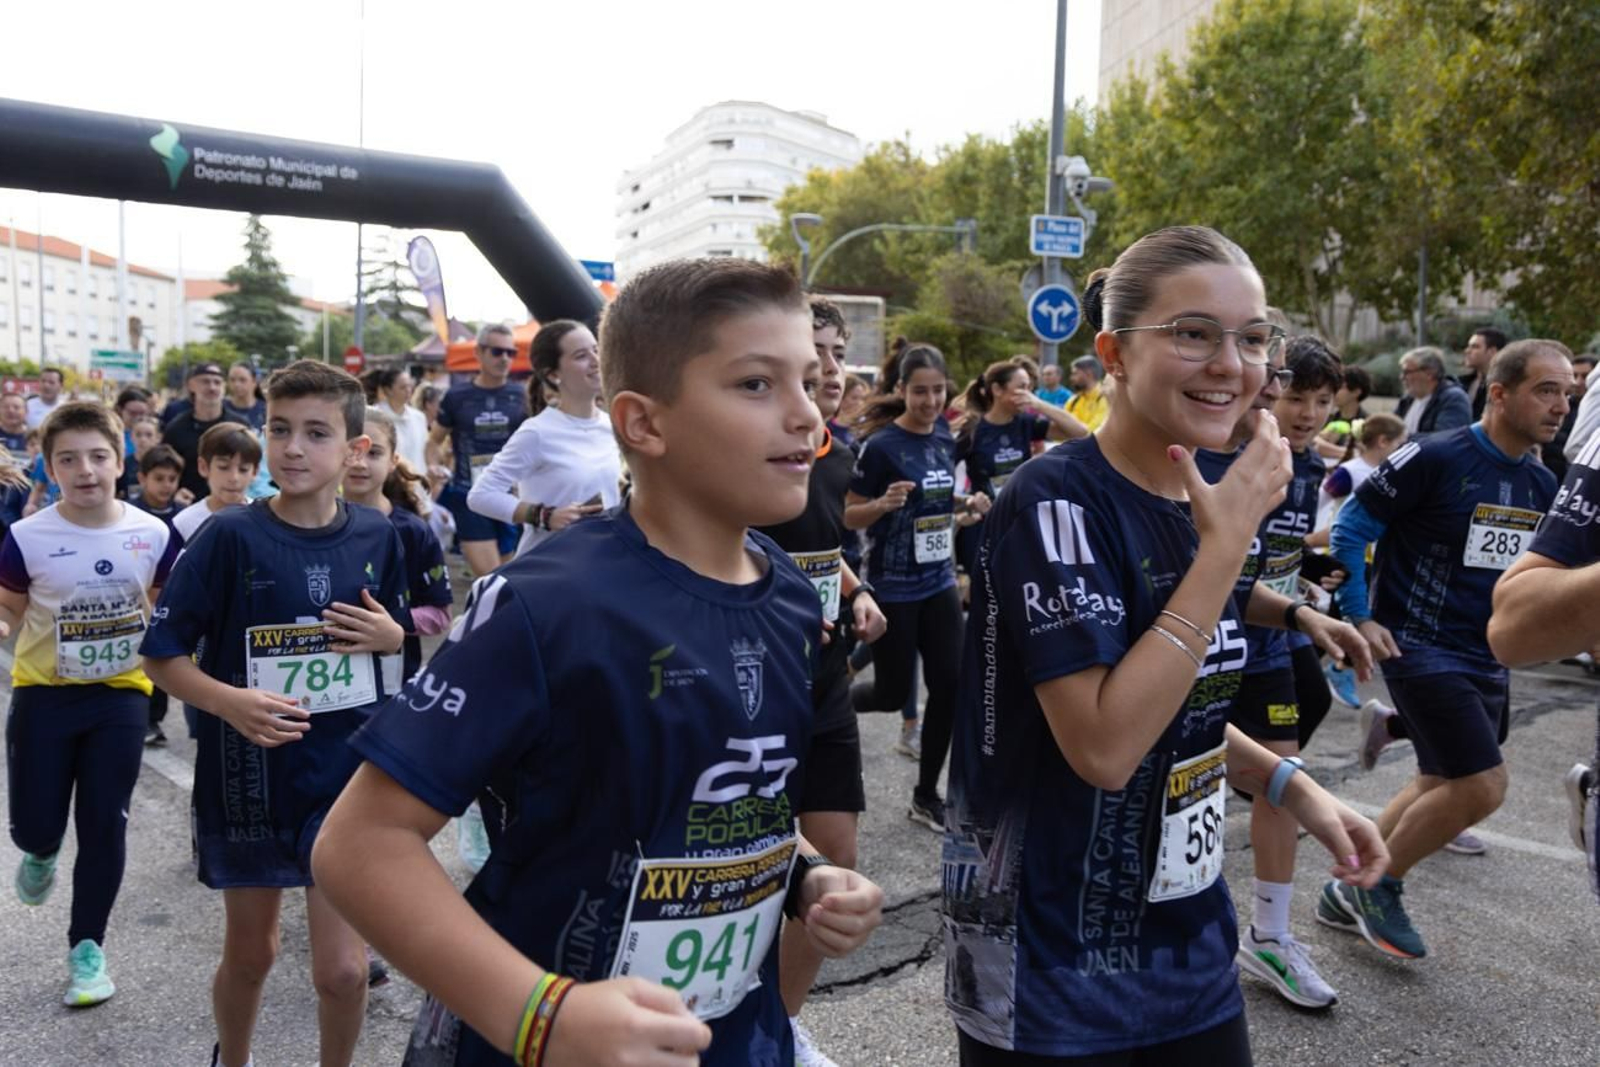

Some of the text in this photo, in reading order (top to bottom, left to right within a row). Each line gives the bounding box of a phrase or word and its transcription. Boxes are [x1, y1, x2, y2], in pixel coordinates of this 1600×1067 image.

[193, 147, 359, 180] Patronato Municipal de
[193, 164, 323, 191] Deportes de Jaén
[922, 469, 954, 489] 25
[1266, 510, 1309, 537] 25
[1480, 530, 1521, 556] 283
[818, 580, 838, 606] 61
[60, 602, 107, 613] SANTA
[252, 629, 283, 648] XXV
[297, 635, 324, 646] gran
[79, 639, 131, 667] 943
[277, 653, 354, 695] 784
[692, 734, 799, 802] 25
[641, 869, 693, 900] XXV
[694, 863, 755, 883] CARRERA
[692, 884, 704, 899] y
[709, 879, 746, 898] gran
[684, 902, 702, 916] LA
[1084, 868, 1112, 940] SANTA
[661, 913, 759, 991] 941
